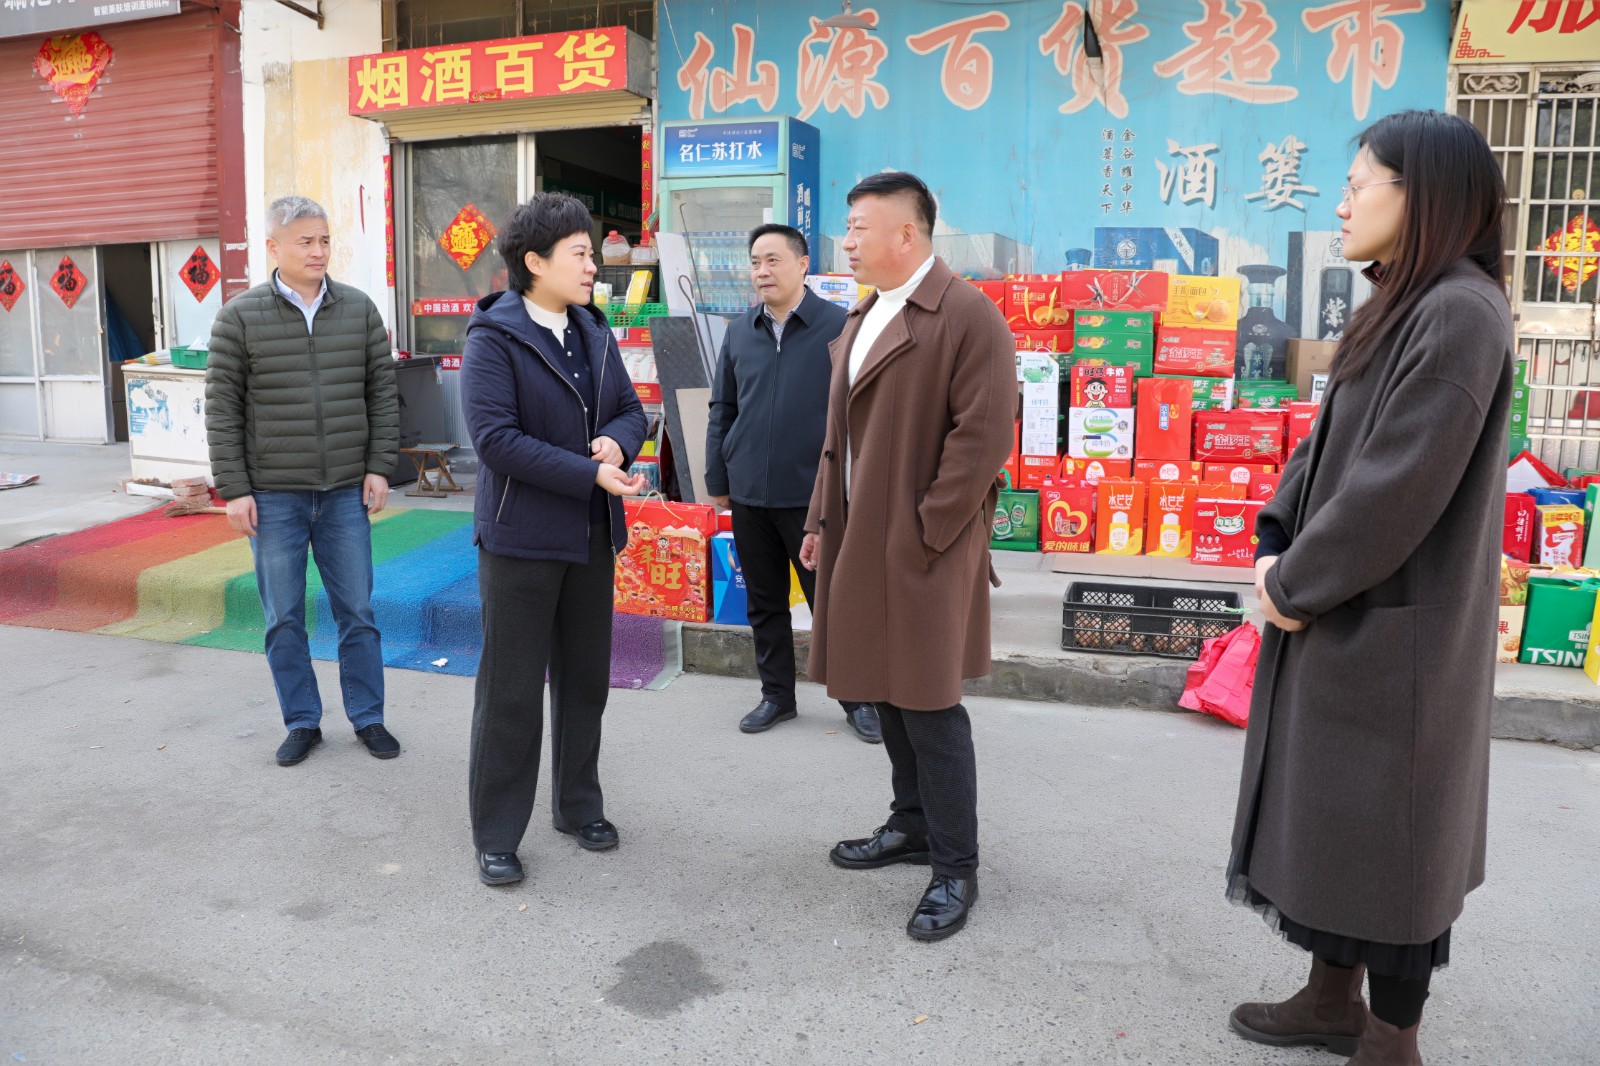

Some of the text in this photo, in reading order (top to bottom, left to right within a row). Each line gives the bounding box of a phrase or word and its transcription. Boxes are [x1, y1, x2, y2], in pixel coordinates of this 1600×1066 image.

[355, 31, 616, 109] 烟酒百货
[679, 140, 763, 163] 名仁苏打水
[424, 303, 459, 313] 中国劲酒
[442, 357, 461, 368] 劲酒
[1044, 540, 1091, 552] 爱的味道
[1526, 646, 1586, 667] TSIN
